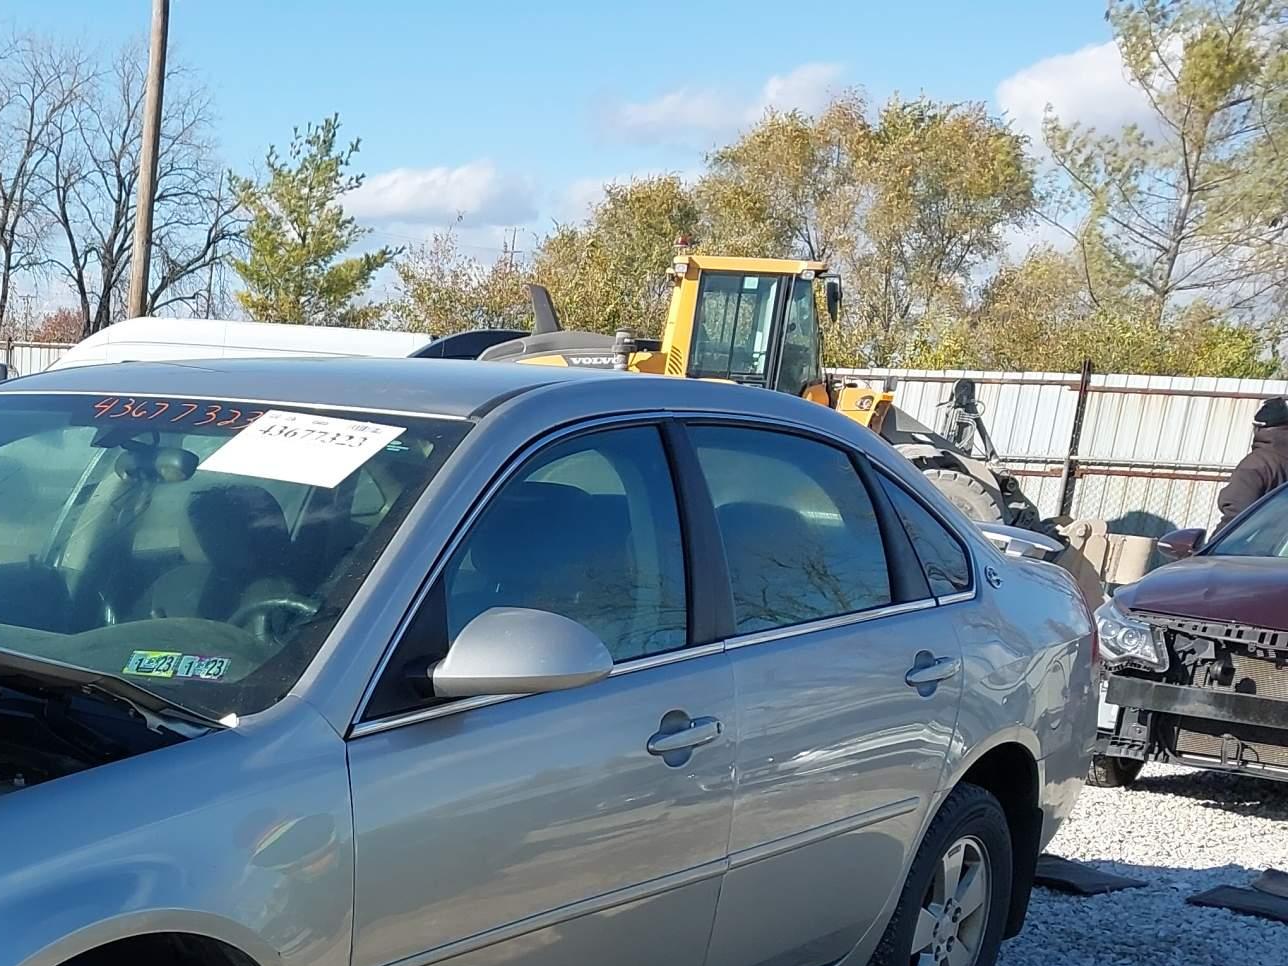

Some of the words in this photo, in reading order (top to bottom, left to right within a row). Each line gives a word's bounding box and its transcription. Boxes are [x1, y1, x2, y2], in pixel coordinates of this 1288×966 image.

[94, 397, 264, 429] 43677323
[259, 424, 368, 448] 43677323
[205, 659, 224, 676] 23
